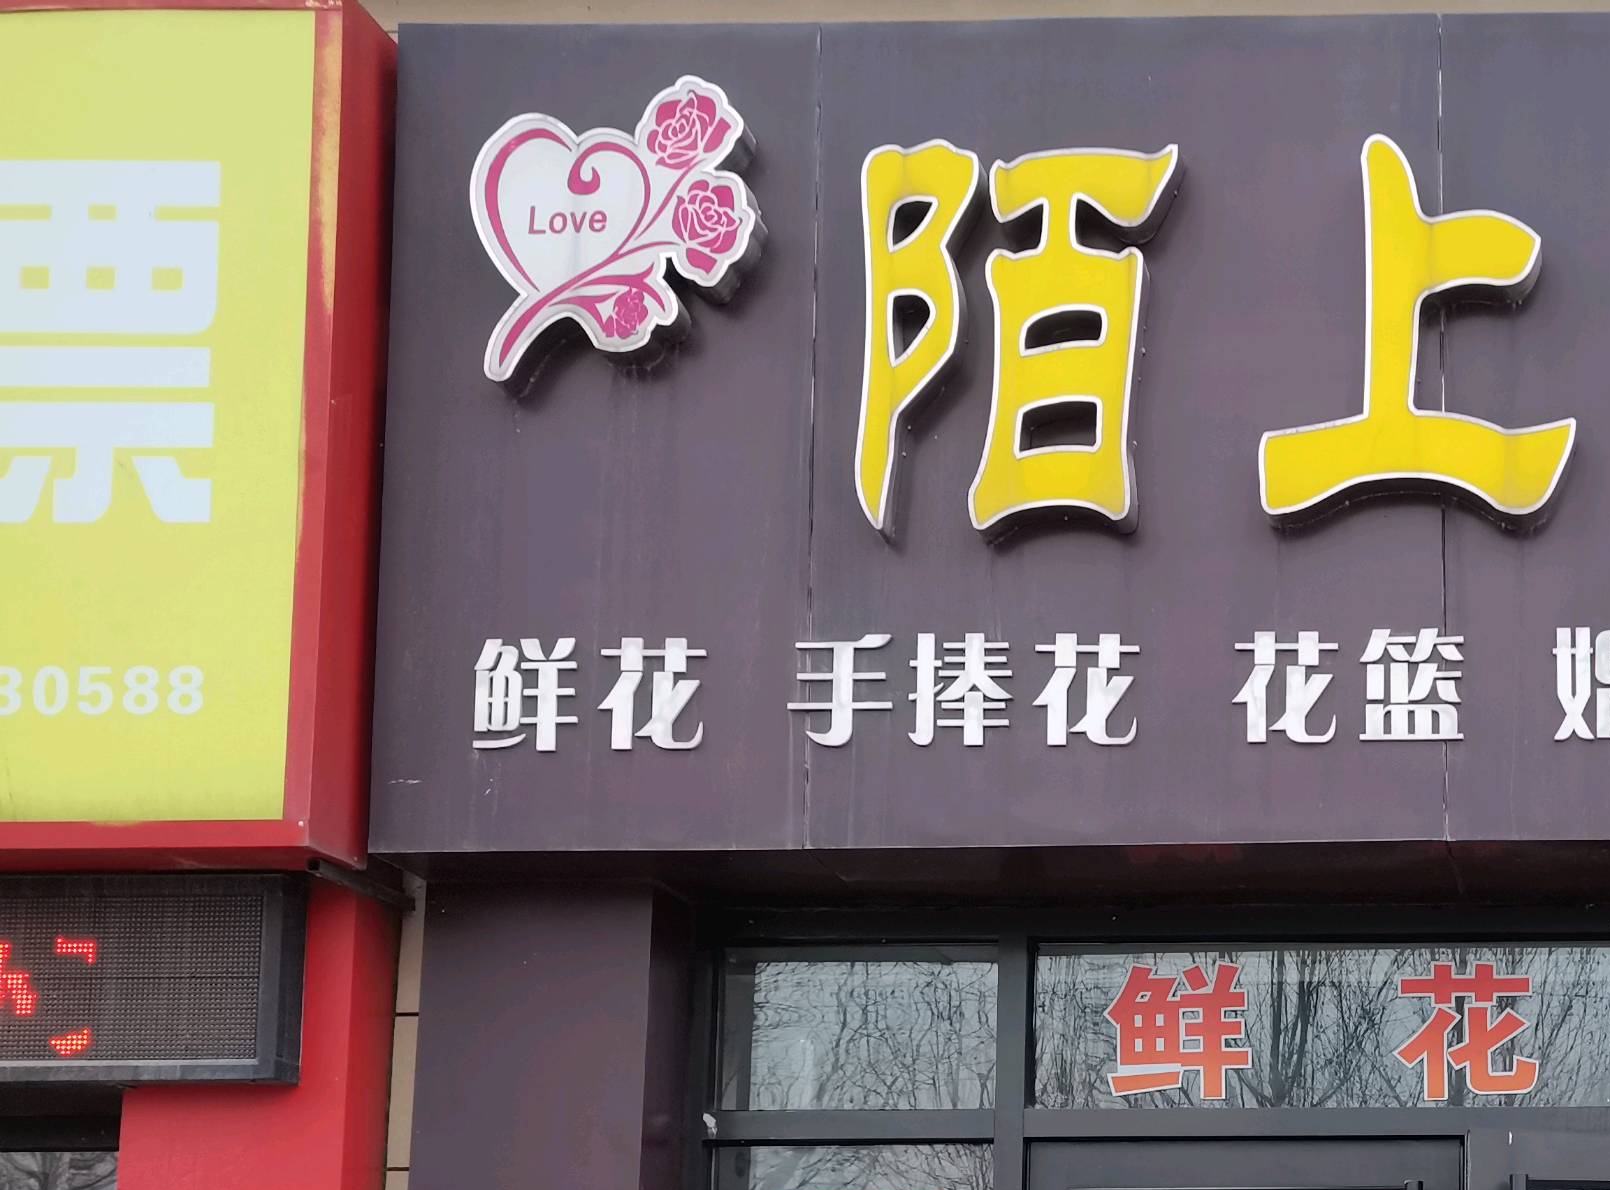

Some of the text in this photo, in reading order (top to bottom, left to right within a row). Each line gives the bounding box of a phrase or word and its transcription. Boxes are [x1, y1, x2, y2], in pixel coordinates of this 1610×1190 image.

[528, 205, 607, 234] Love
[0, 159, 221, 524] 票
[472, 636, 708, 751] 鲜花
[787, 632, 1141, 748] 手捧花
[1231, 628, 1465, 744] 花篮
